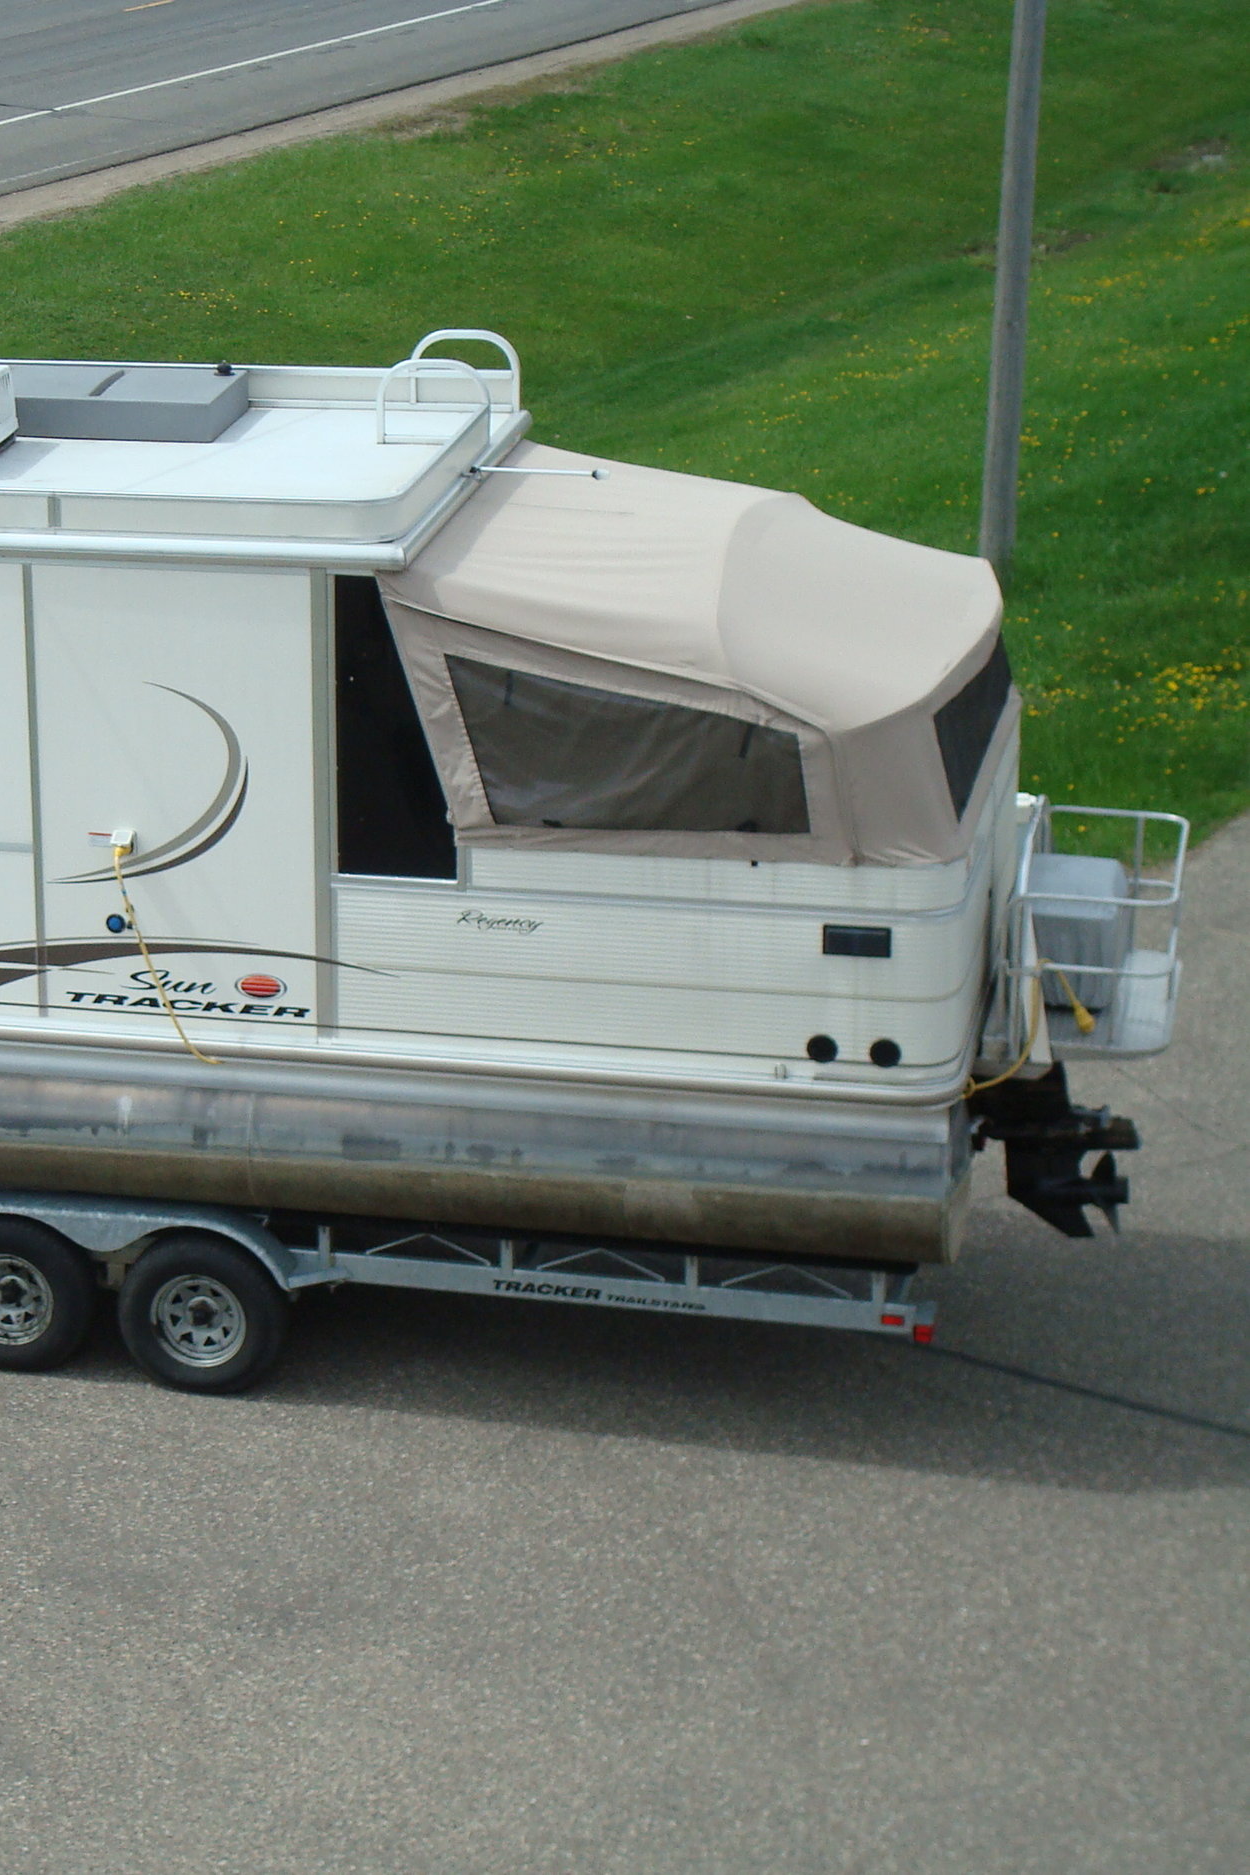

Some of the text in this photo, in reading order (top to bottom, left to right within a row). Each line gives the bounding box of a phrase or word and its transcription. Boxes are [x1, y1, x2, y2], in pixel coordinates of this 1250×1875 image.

[456, 909, 544, 936] Regency
[120, 969, 217, 995] Sun
[65, 991, 310, 1018] TRACKER
[493, 1279, 602, 1300] TRACKER
